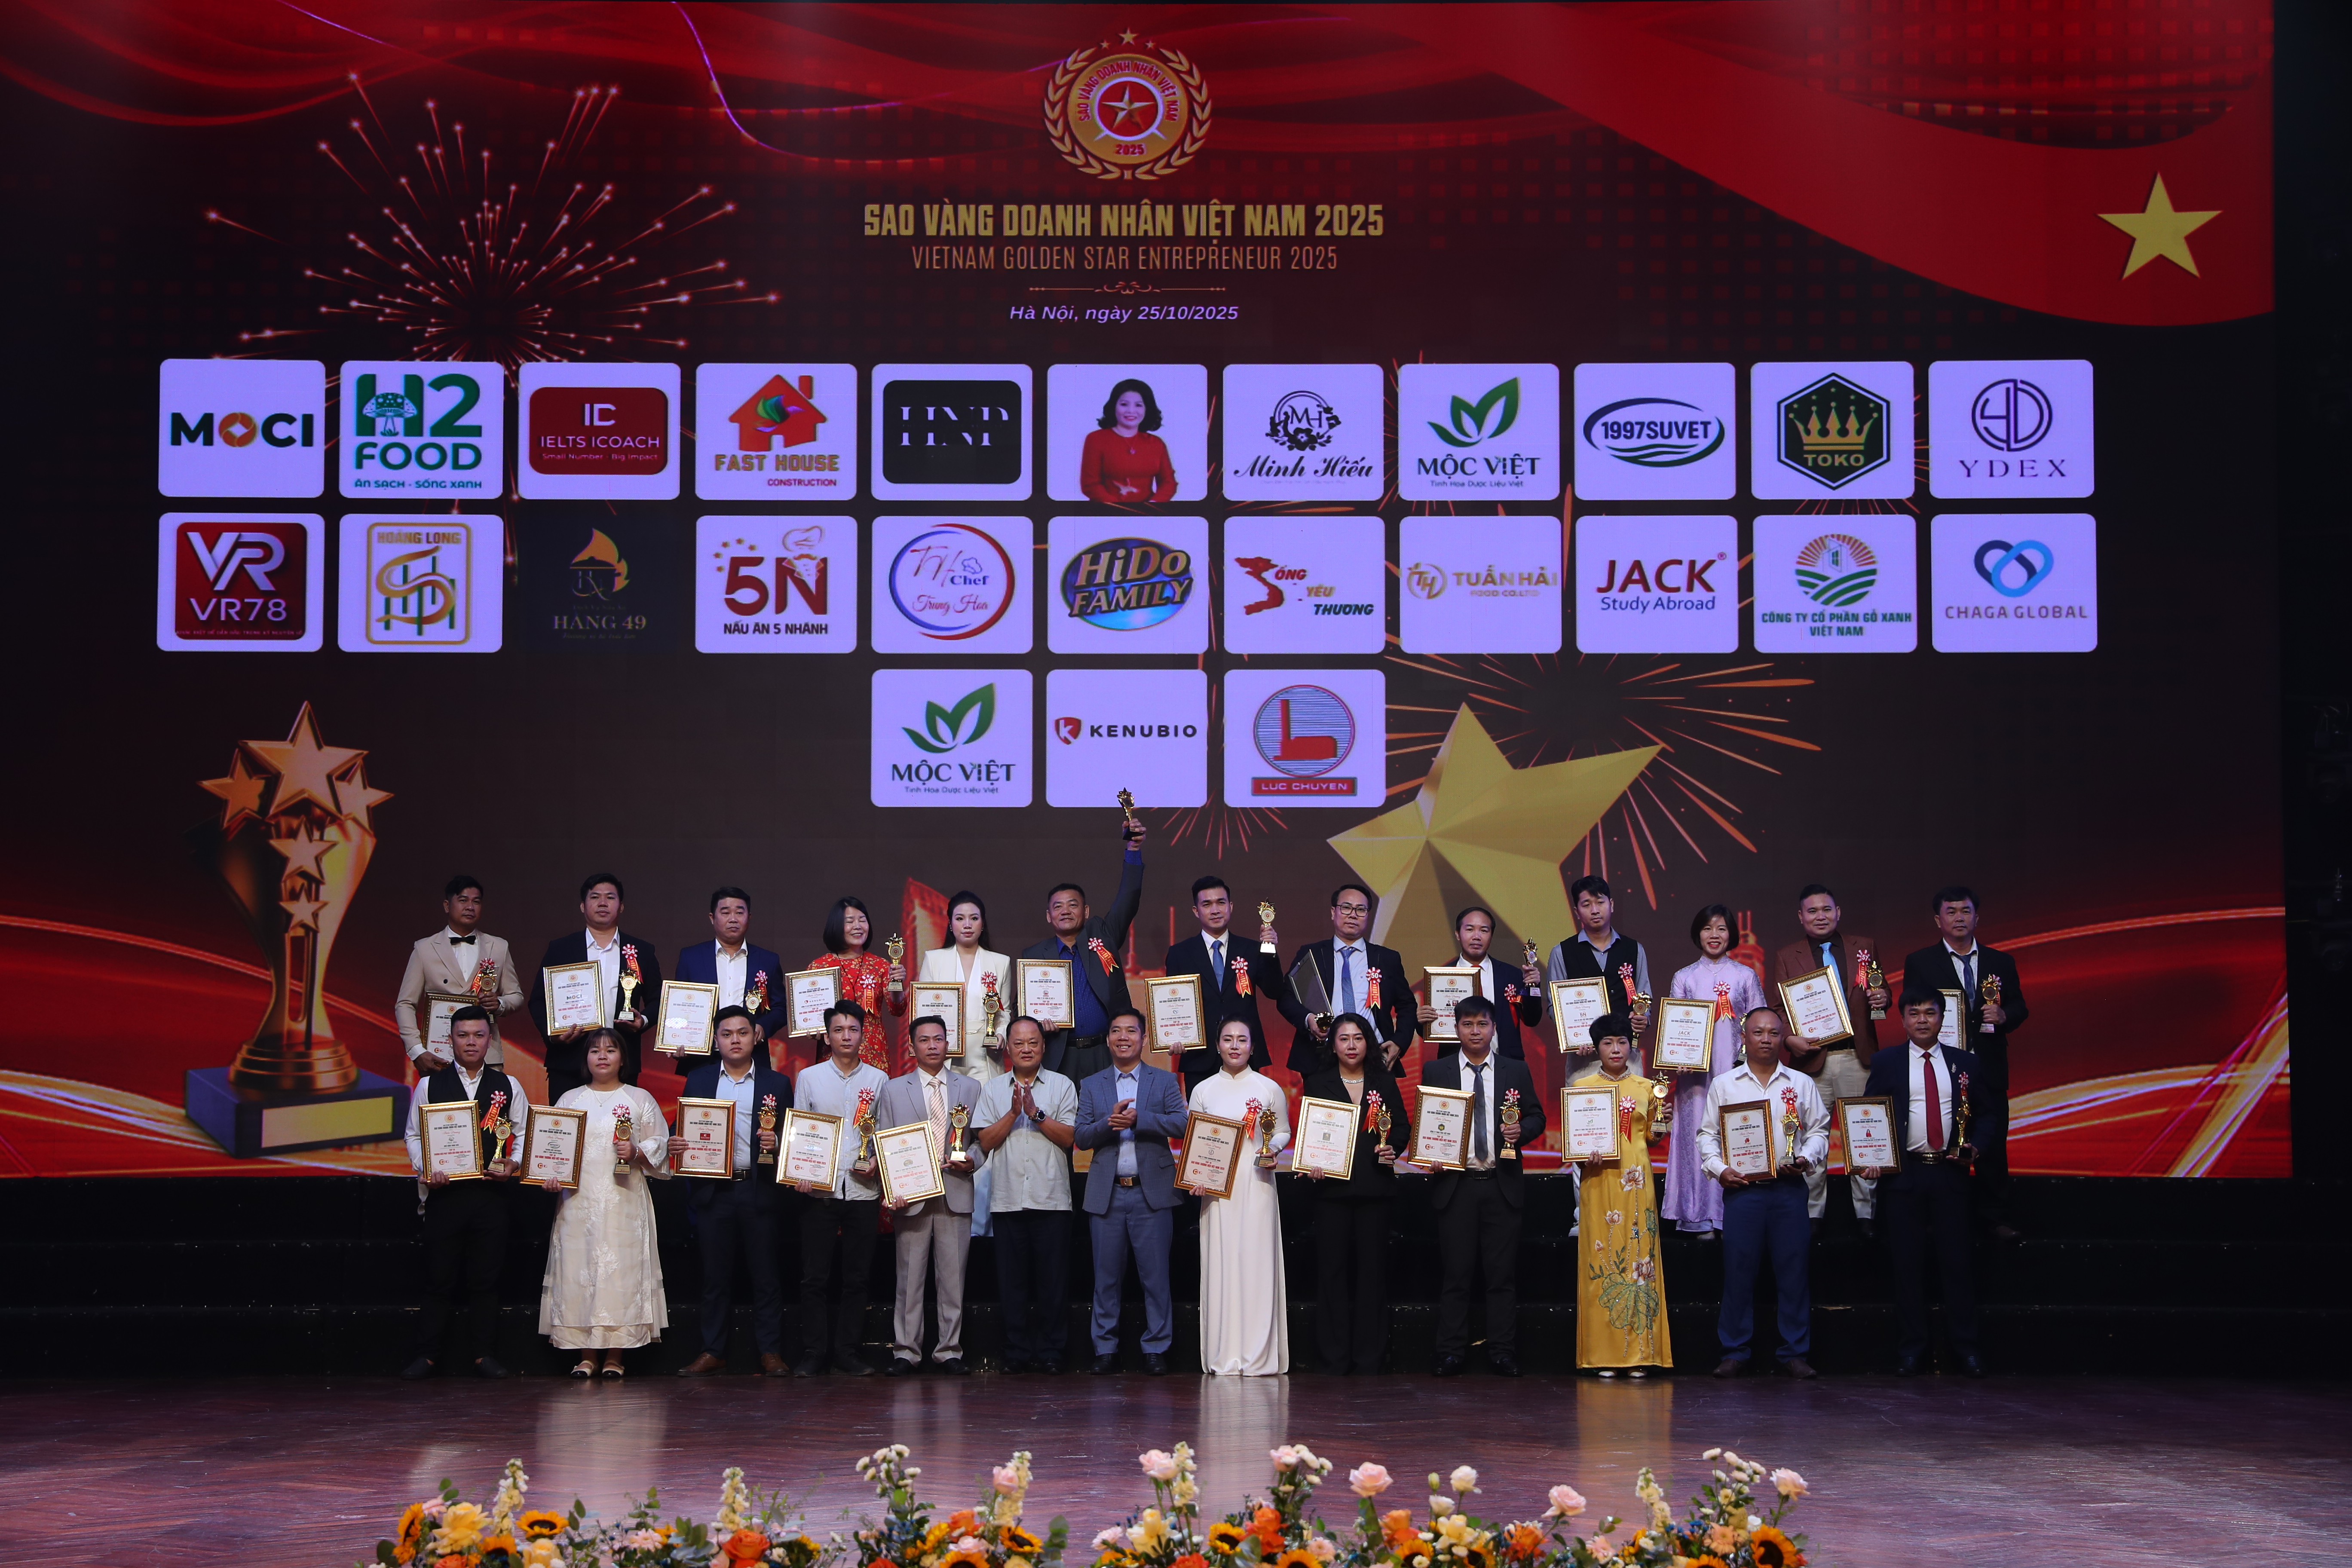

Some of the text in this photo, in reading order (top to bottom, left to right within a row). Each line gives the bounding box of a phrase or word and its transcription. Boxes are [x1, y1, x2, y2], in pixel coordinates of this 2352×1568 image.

[1096, 61, 1131, 80] DOANH
[1132, 61, 1162, 81] NHÂN
[1078, 76, 1099, 100] VÀNG
[1077, 102, 1091, 122] SAO
[1165, 100, 1179, 122] NAM
[1115, 143, 1146, 156] 2025
[864, 198, 1384, 244] SAO VÀNG DOANH NHÂN VIỆT NAM 2025
[912, 246, 1338, 270] VIETNAM GOLDEN STAR ENTREPRENEUR 2025
[1010, 305, 1239, 323] Hà Nội, ngày 25/10/2025
[355, 373, 482, 438] H2
[171, 412, 314, 448] MOCI
[1601, 420, 1711, 440] 1997SUVET
[541, 436, 659, 448] IELTS ICOACH
[355, 442, 482, 470] FOOD
[715, 454, 839, 471] FAST HOUSE
[1234, 454, 1373, 477] Minh Hiếu
[1418, 453, 1541, 479] MỘC VIỆT
[1804, 454, 1865, 467] TOKO
[1959, 459, 2067, 478] YDEX
[374, 480, 404, 490] SẠCH
[768, 478, 837, 487] CONSTRUCTION
[426, 532, 461, 544] LONG
[186, 532, 285, 591] VR
[1074, 546, 1188, 586] HiDo
[724, 556, 828, 616] 5N
[950, 575, 989, 585] Chef
[1596, 559, 1716, 593] JACK
[1070, 579, 1191, 616] FAMILY
[1306, 584, 1335, 597] YÊU
[188, 598, 287, 622] VR78
[1601, 596, 1715, 614] Study Abroad
[1945, 606, 2088, 619] CHAGA GLOBAL
[622, 615, 647, 630] 49
[1762, 611, 1792, 623] CÔNG
[1795, 612, 1808, 623] TY
[1881, 612, 1911, 623] XANH
[1837, 626, 1864, 636] NAM
[1090, 724, 1197, 738] KENUBIO
[892, 759, 1016, 786] MỘC VIỆT
